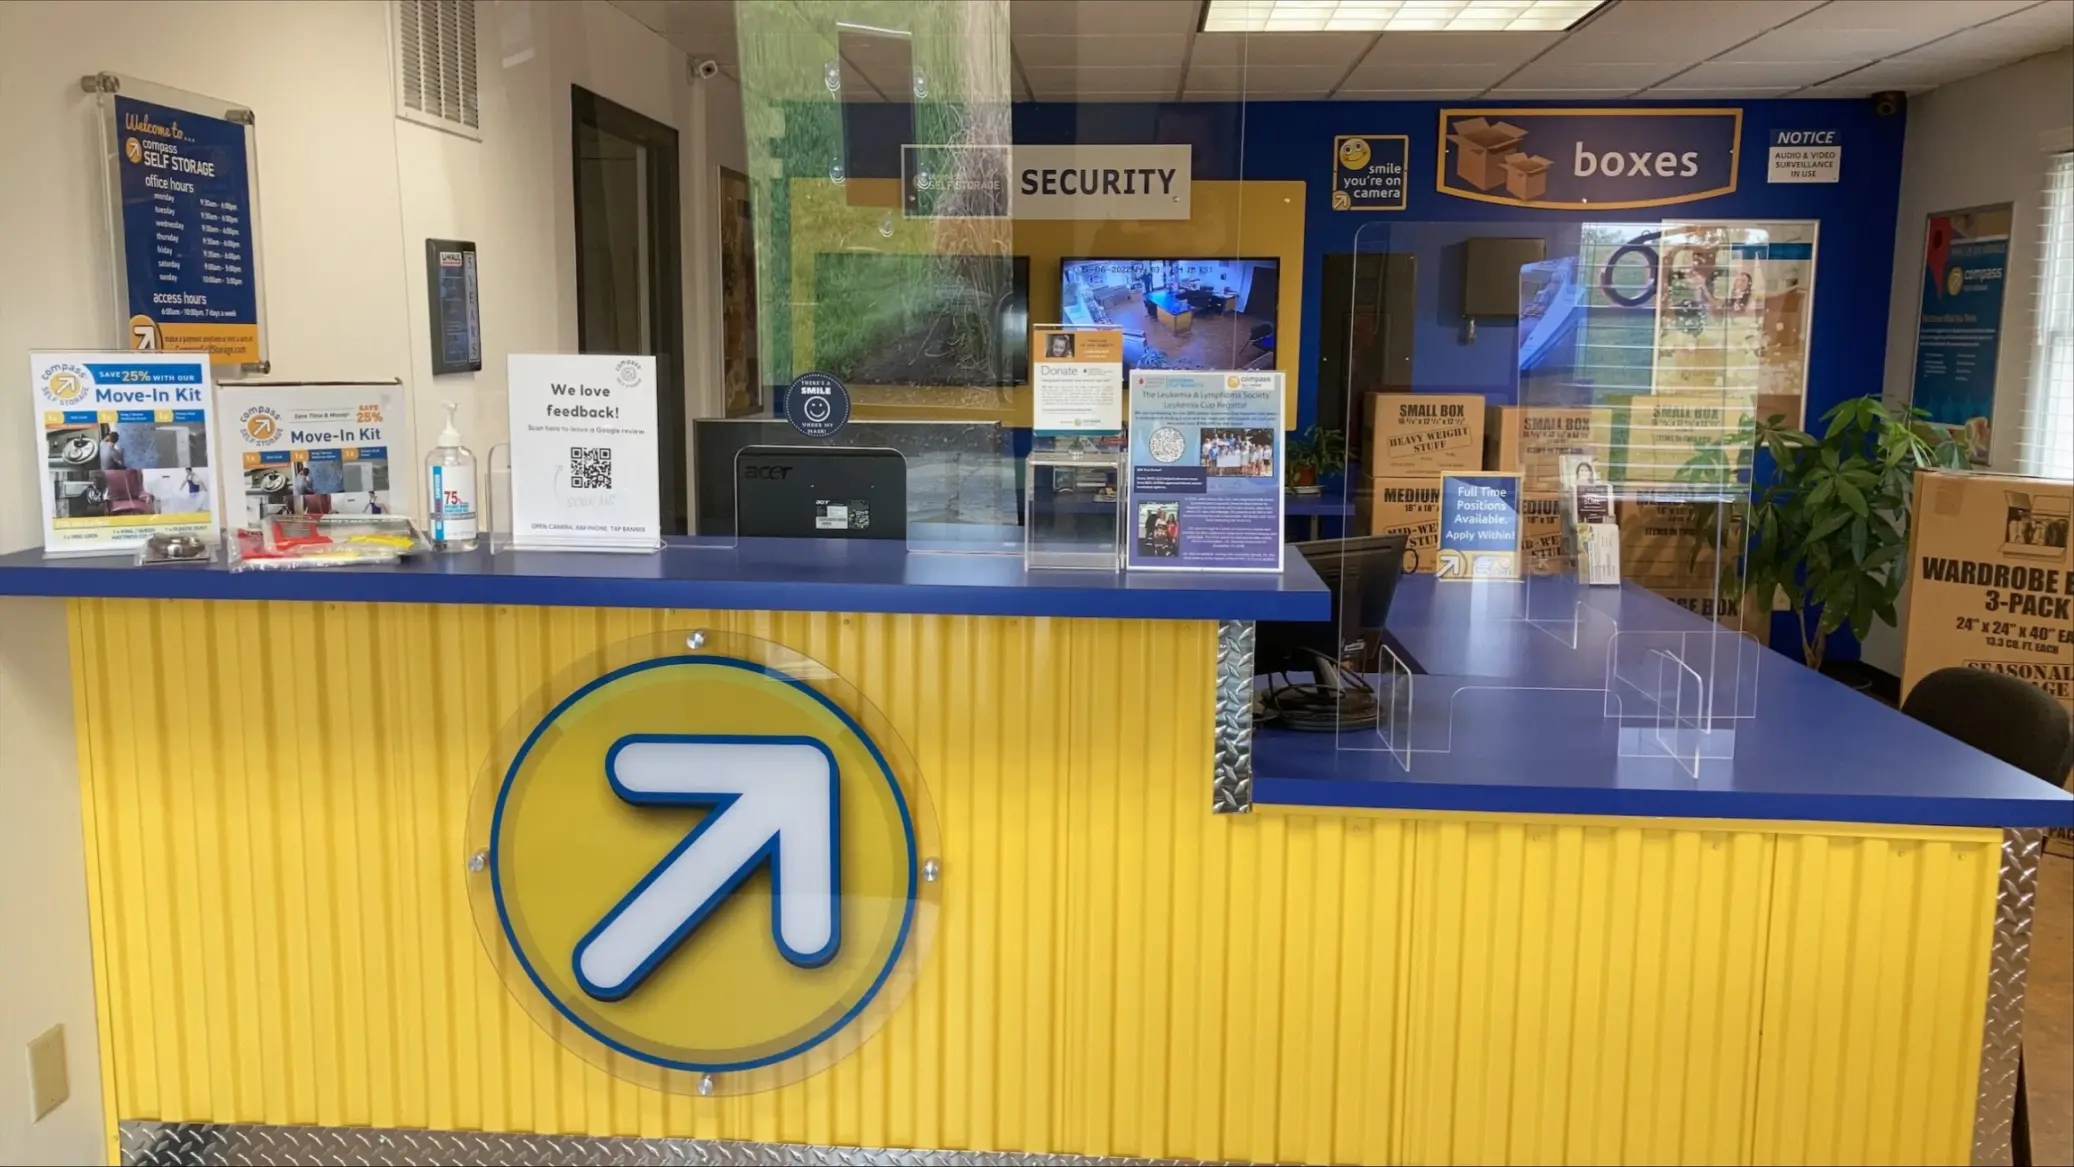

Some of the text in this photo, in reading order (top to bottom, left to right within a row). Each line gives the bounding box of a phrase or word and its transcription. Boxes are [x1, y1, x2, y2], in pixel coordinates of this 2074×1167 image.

[126, 112, 171, 137] Welcome
[1778, 131, 1836, 144] NOTICE
[142, 139, 178, 154] compass
[1574, 141, 1699, 177] boxes
[1811, 151, 1836, 159] VIDEO
[143, 151, 215, 177] SELF STORAGE
[1369, 163, 1402, 174] smile
[1775, 161, 1834, 169] SURVEILLANCE
[1801, 170, 1816, 178] USE
[145, 174, 194, 193] office hours
[1021, 168, 1176, 195] SECURITY
[1343, 175, 1401, 189] you're on
[1353, 189, 1401, 198] camera
[1964, 268, 2003, 283] compass
[153, 291, 207, 305] access hours
[41, 362, 88, 381] compass
[121, 370, 151, 382] 25%
[1041, 365, 1078, 376] Donate
[41, 386, 89, 406] SELF STORAGE
[95, 387, 202, 403] Move-In Kit
[551, 383, 611, 397] We love
[801, 387, 832, 395] SMILE
[1142, 391, 1270, 400] The Leukemia & Lymphoma Society
[358, 404, 379, 412] SAVE
[547, 404, 619, 419] feedback!
[1164, 401, 1200, 409] Leukemia
[1200, 402, 1216, 410] Cup
[1399, 404, 1464, 417] SMALL BOX
[240, 405, 282, 423] compass
[356, 412, 384, 423] 25%
[570, 425, 588, 433] leave
[596, 426, 620, 435] Google
[1524, 418, 1590, 431] SMALL BOX
[240, 428, 284, 447] SELF STORAGE
[291, 427, 381, 444] Move-In Kit
[1389, 427, 1469, 447] HEAVY WEIGHT
[1413, 440, 1446, 453] STUFF
[744, 465, 793, 480] acer
[1384, 487, 1440, 503] MEDIUM
[1458, 486, 1507, 498] Full Time
[1456, 500, 1506, 511] Positions
[531, 522, 548, 530] OPEN
[1454, 513, 1508, 525] Available.
[1446, 530, 1515, 541] Apply Within!
[1922, 556, 2059, 594] WARDROBE
[1702, 597, 1738, 617] BOX
[1985, 590, 2070, 620] 3-PACK
[1956, 616, 1980, 631] 24"
[1981, 621, 1990, 633] x
[1992, 621, 2017, 636] 24"
[2019, 626, 2027, 638] x
[2029, 626, 2056, 641] 40"
[1986, 636, 2004, 647] 13.3
[2022, 641, 2034, 651] FT.
[2035, 643, 2059, 655] EACH
